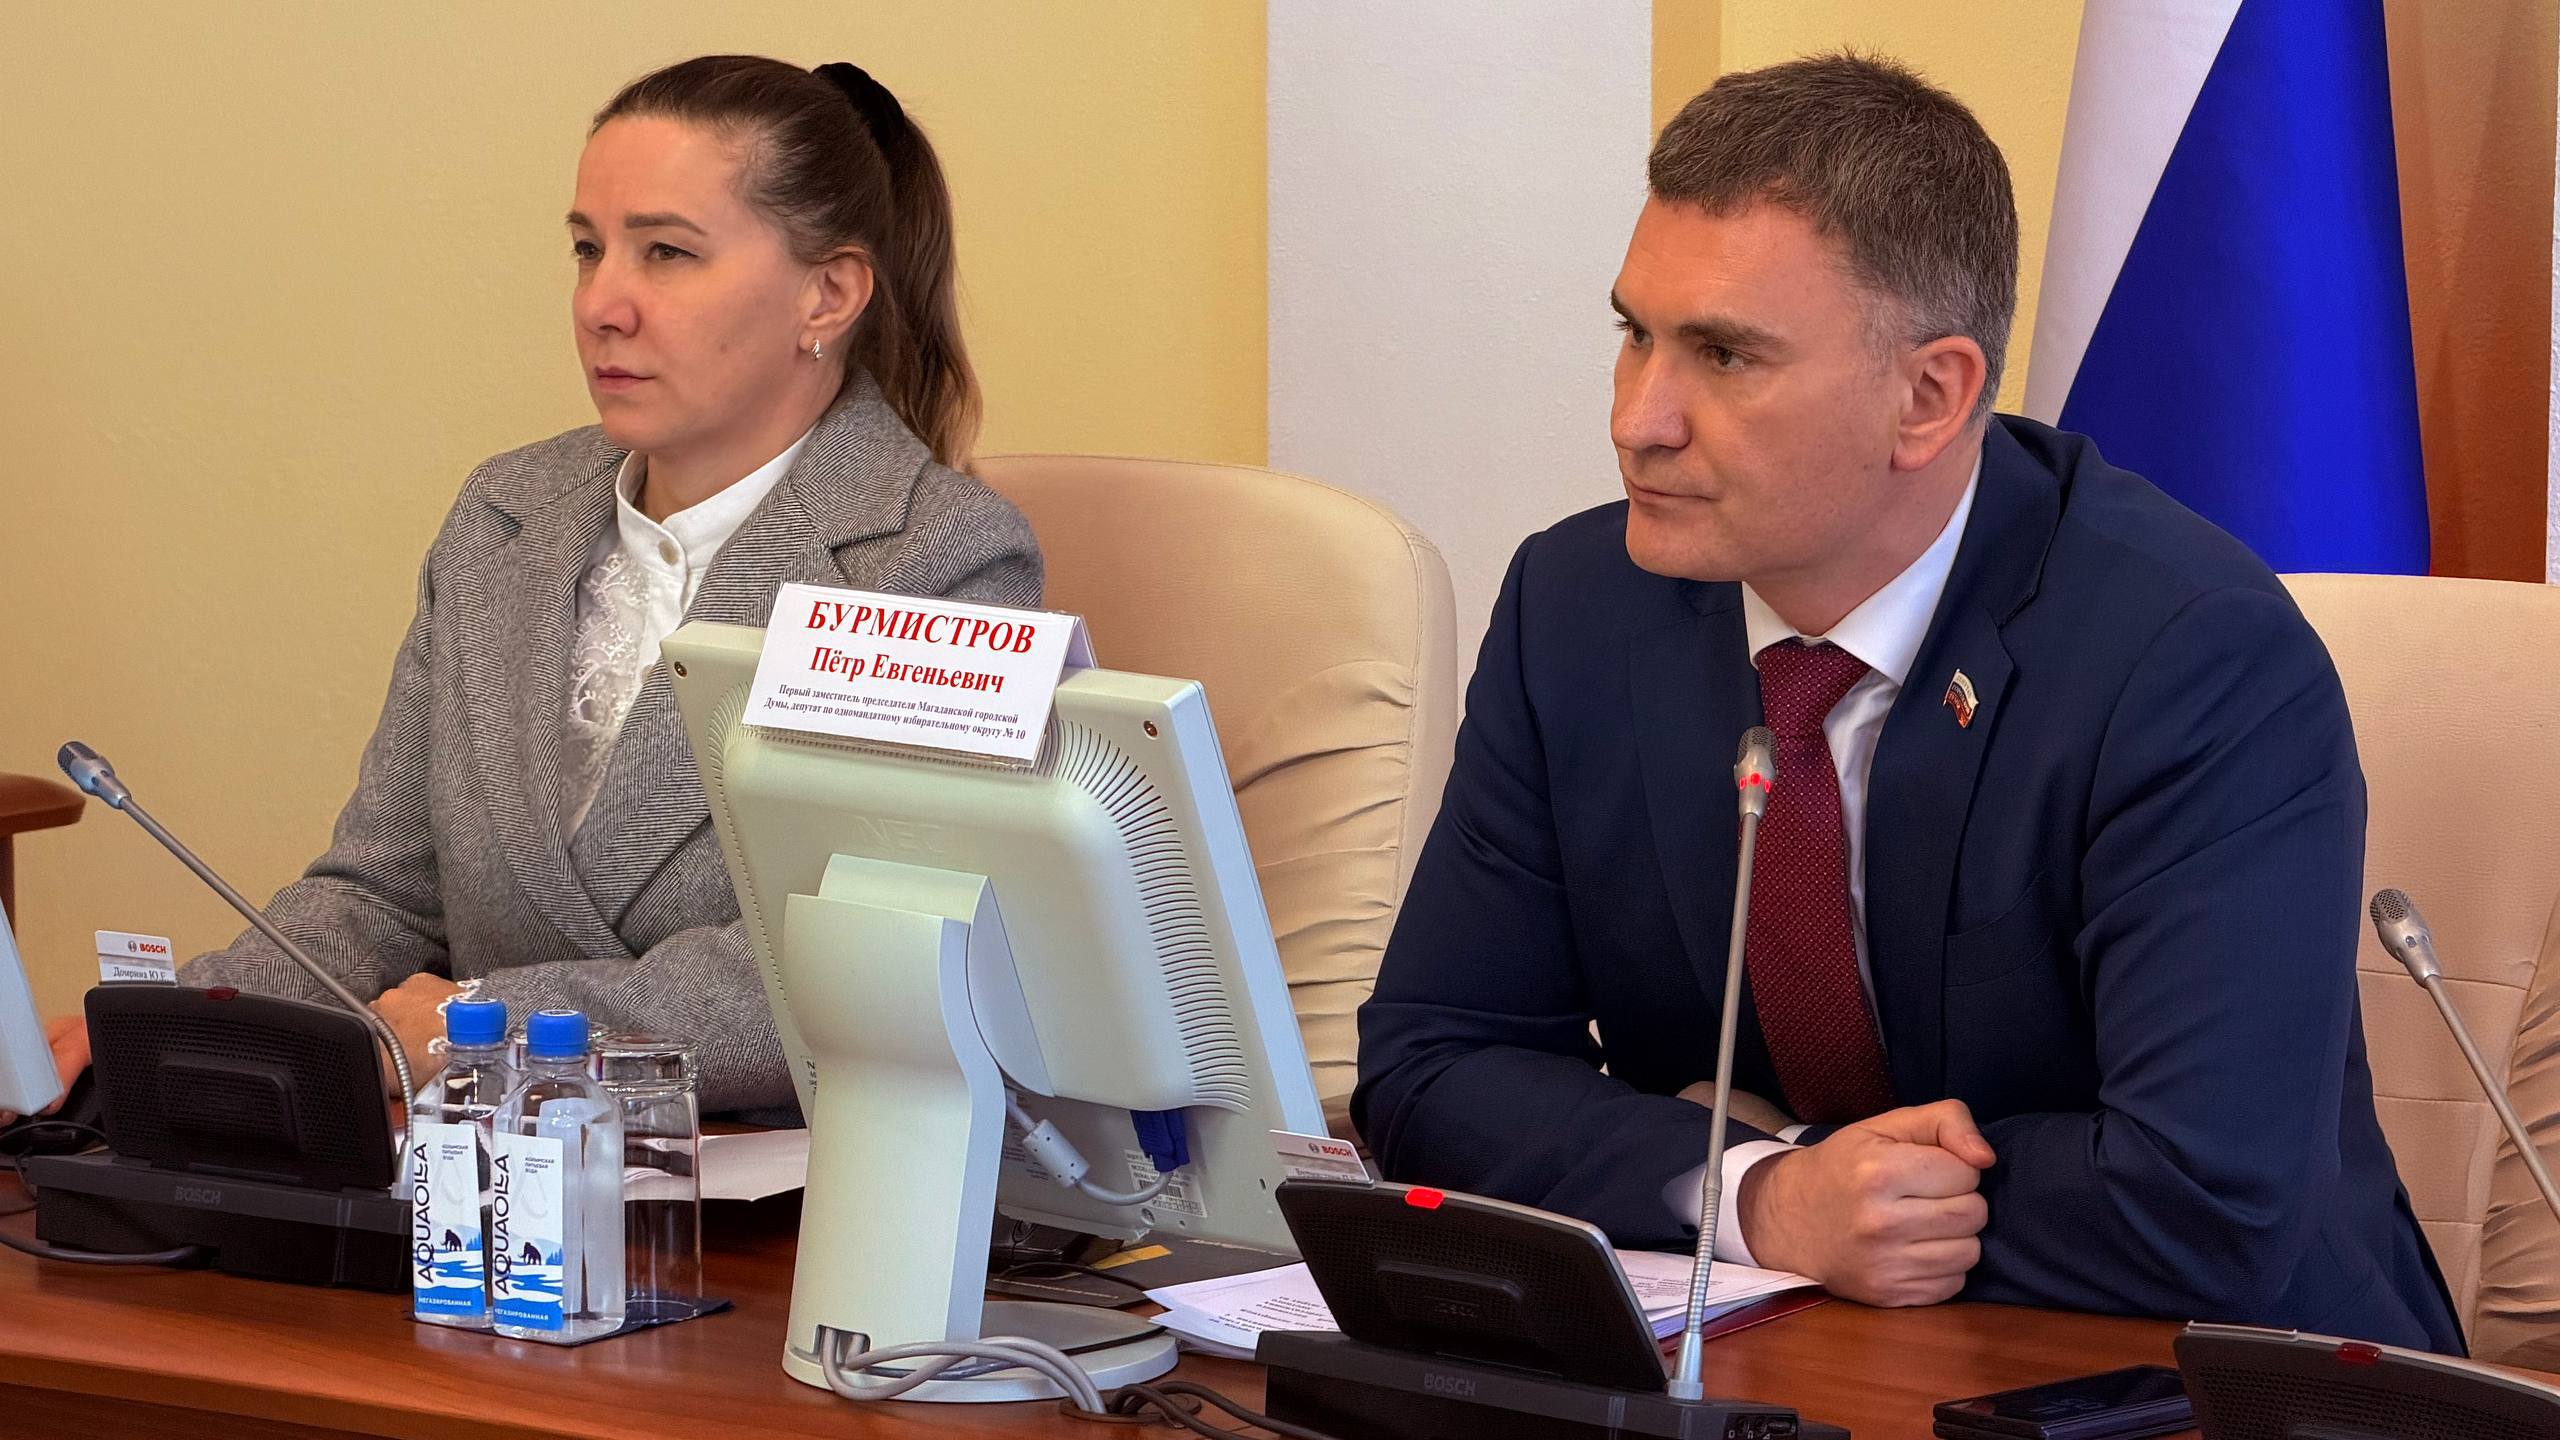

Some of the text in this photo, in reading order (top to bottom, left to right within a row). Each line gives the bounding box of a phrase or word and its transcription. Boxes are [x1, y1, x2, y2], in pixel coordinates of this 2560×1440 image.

[805, 600, 1036, 654] БУРМИСТРОВ
[809, 646, 1005, 694] Пётр Евгеньевич
[764, 697, 1026, 740] Думы, депутат по одномандатному избирательному округу № 10
[779, 684, 1019, 725] Первый заместитель председателя Магаданской городской
[139, 944, 167, 954] BOSCH
[1321, 1145, 1353, 1157] BOSCH
[175, 1185, 222, 1206] BOSCH
[1423, 1373, 1477, 1397] BOSCH
